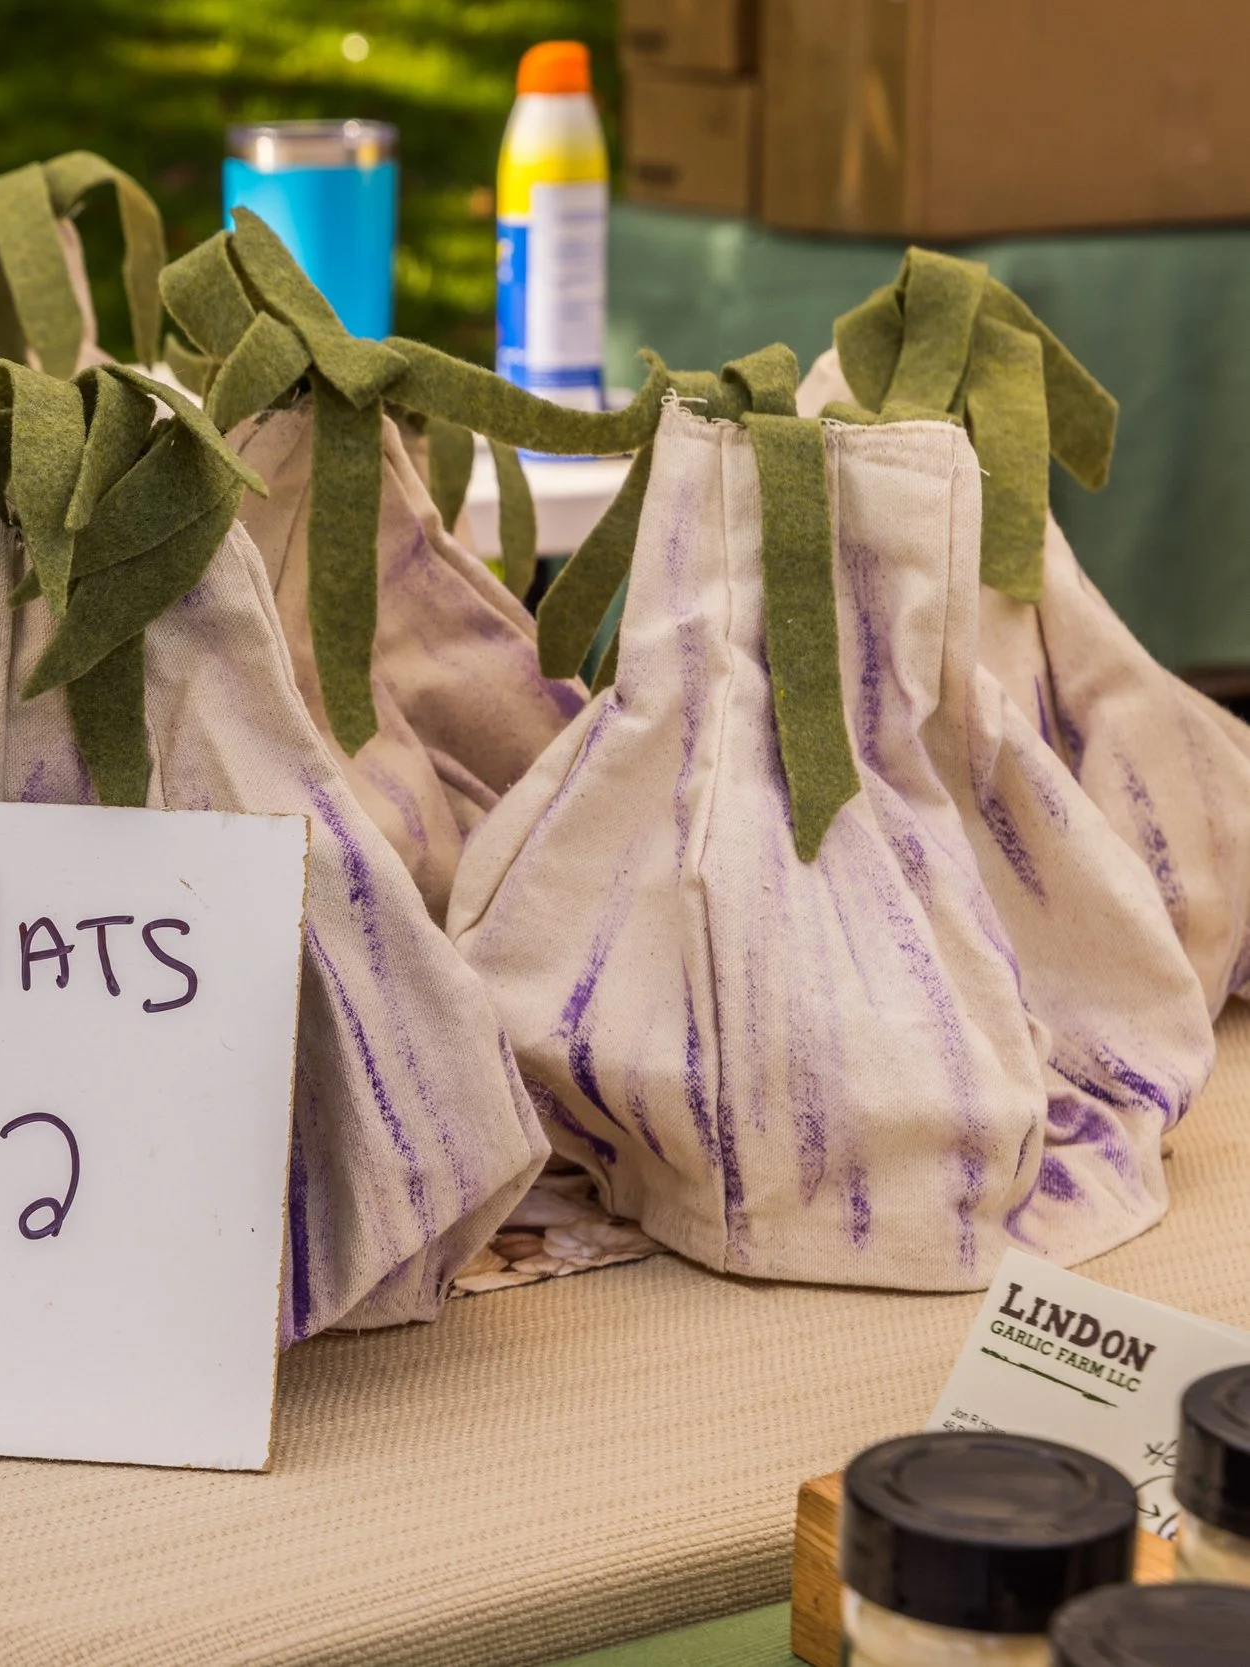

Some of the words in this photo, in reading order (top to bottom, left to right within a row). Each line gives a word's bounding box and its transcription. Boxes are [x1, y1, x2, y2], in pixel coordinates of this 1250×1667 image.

[990, 1320, 1053, 1356] GARLIC
[1055, 1347, 1105, 1378] FARM
[1106, 1368, 1141, 1393] LLC
[999, 1282, 1157, 1372] LINDON
